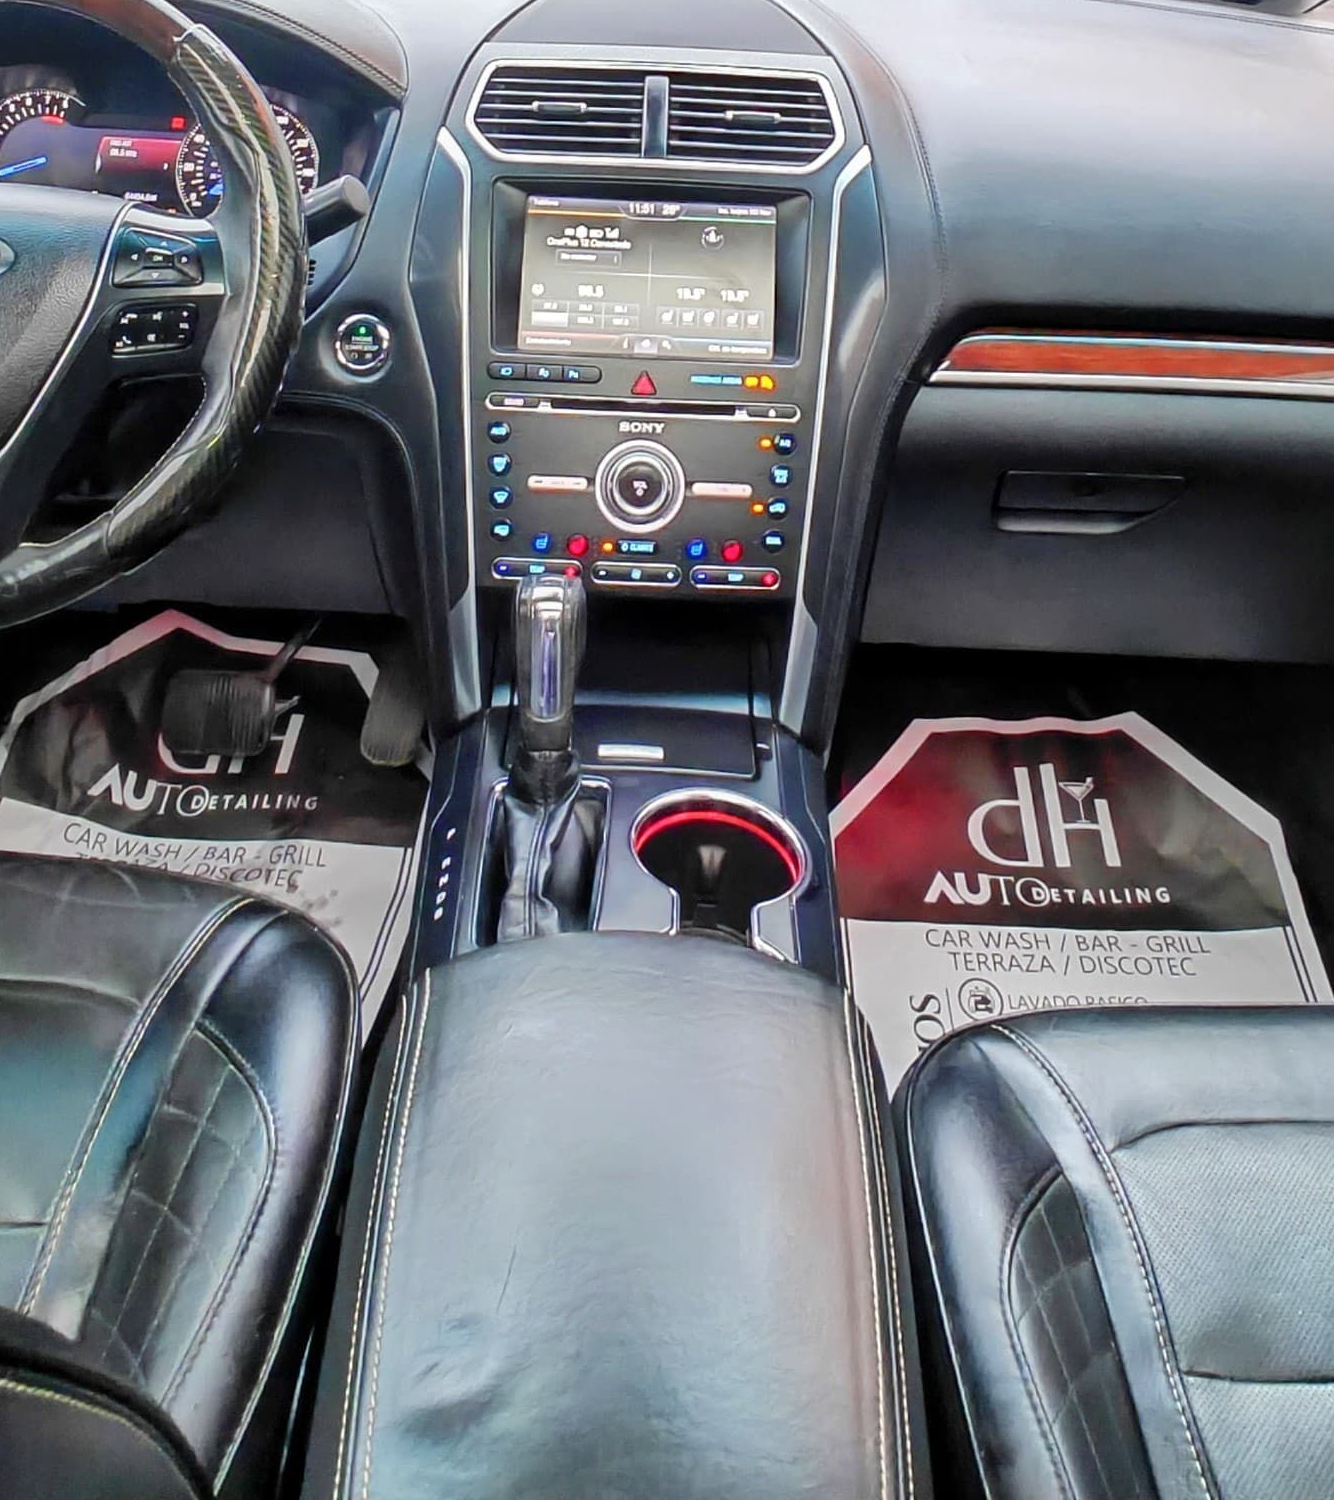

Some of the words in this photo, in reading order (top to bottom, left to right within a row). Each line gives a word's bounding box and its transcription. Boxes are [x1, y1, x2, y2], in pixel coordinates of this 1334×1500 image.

[618, 420, 666, 434] SONY
[63, 822, 107, 853] CAR
[116, 836, 183, 861] WASH
[202, 846, 247, 865] BAR
[269, 844, 327, 868] GRILL
[192, 862, 304, 890] DISCOTEC
[925, 928, 972, 948] CAR
[978, 931, 1052, 951] WASH
[1074, 934, 1123, 953] BAR
[1145, 935, 1212, 955] GRILL
[947, 951, 1056, 974] TERRAZA
[1079, 954, 1197, 977] DISCOTEC
[1007, 994, 1082, 1011] LAVADO
